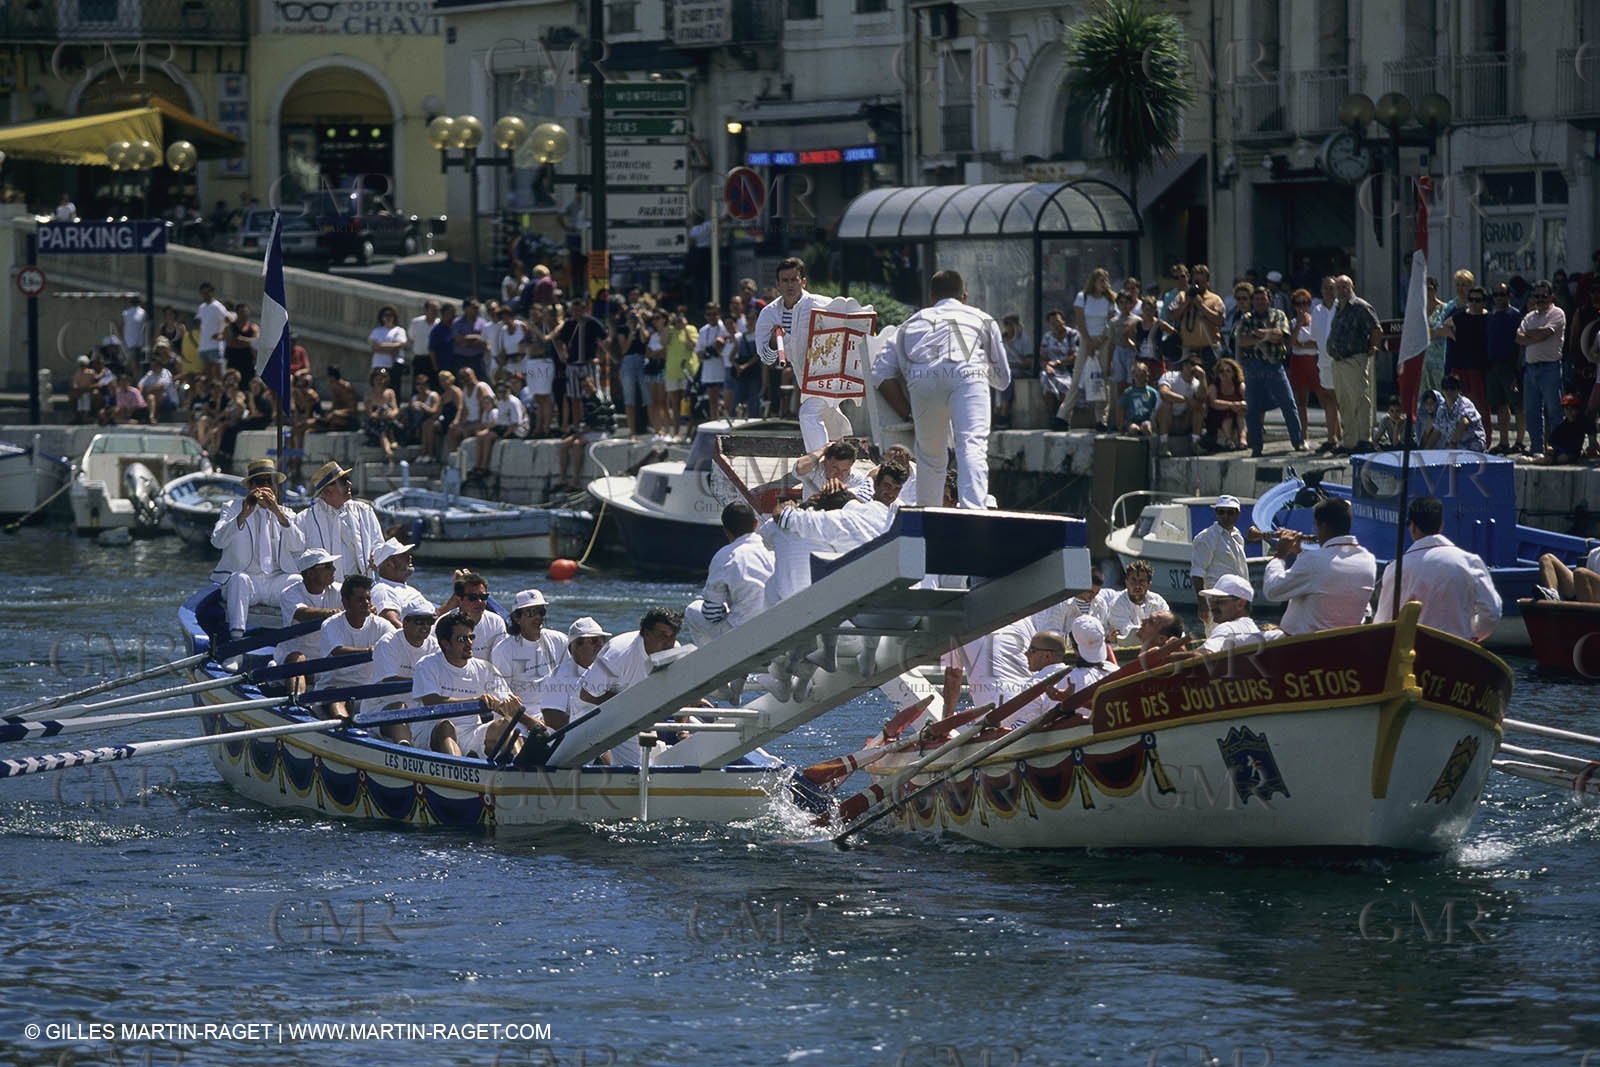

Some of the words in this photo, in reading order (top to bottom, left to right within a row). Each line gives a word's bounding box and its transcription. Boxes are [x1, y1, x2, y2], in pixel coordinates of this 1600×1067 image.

[39, 226, 133, 249] PARKING
[1484, 222, 1522, 242] GRAND
[1422, 669, 1446, 697] STE
[1450, 680, 1476, 706] DES
[1105, 702, 1132, 728] STE
[1141, 691, 1169, 719] DES
[384, 752, 400, 769] LES
[403, 757, 425, 775] DEUX
[429, 763, 481, 784] CETTOISES
